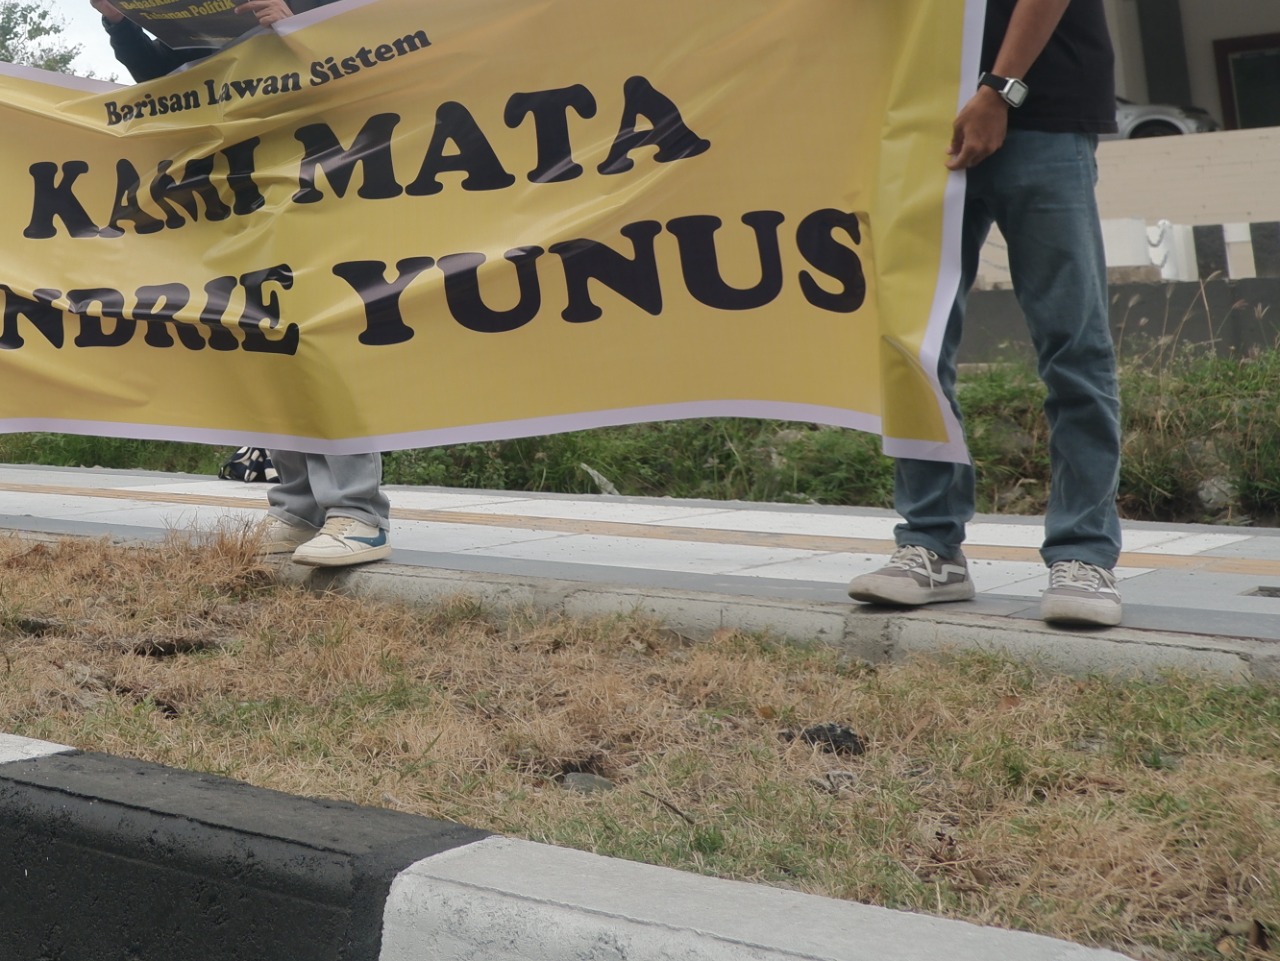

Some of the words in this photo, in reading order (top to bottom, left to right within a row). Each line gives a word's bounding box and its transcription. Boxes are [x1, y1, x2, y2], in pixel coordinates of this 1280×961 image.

[103, 89, 201, 126] Barisan
[204, 70, 303, 106] Lawan
[309, 29, 433, 87] Sistem
[23, 136, 266, 239] KAMI
[291, 75, 712, 204] MATA
[332, 208, 867, 346] YUNUS
